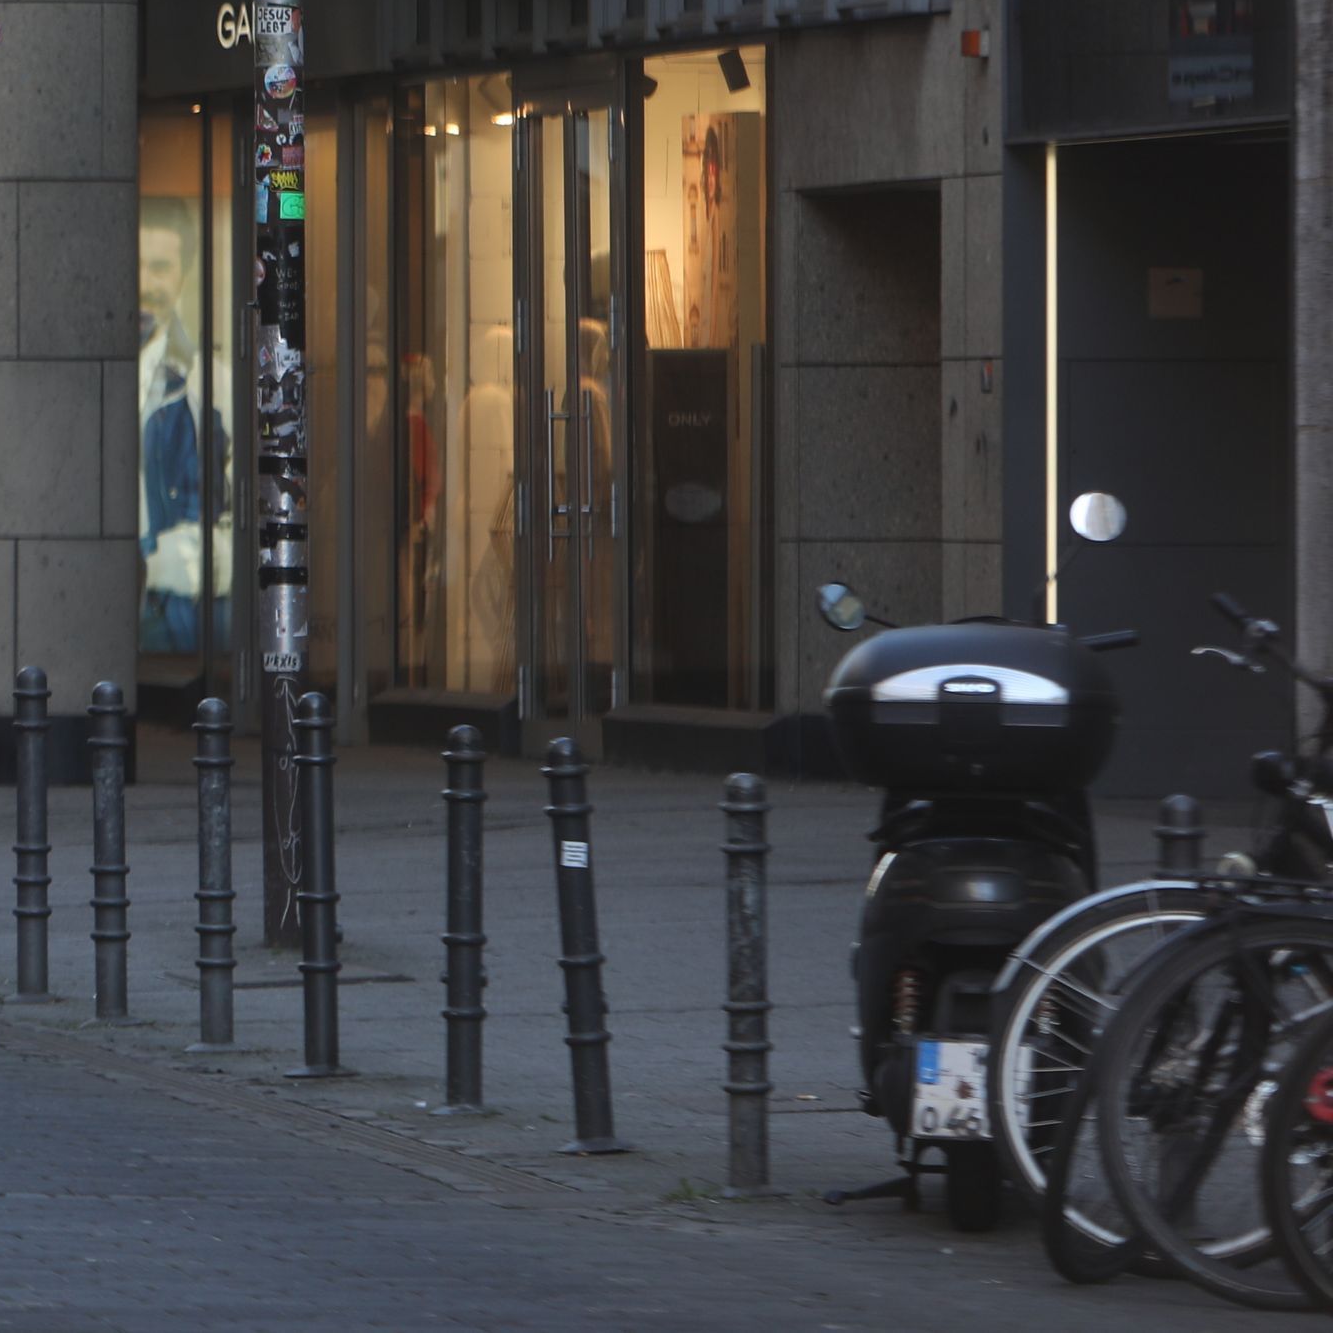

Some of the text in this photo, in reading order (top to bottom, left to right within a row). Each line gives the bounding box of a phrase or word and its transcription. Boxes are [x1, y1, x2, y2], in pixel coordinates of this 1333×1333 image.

[258, 7, 291, 22] JESUS
[217, 1, 255, 49] GA
[259, 21, 288, 34] LEBT
